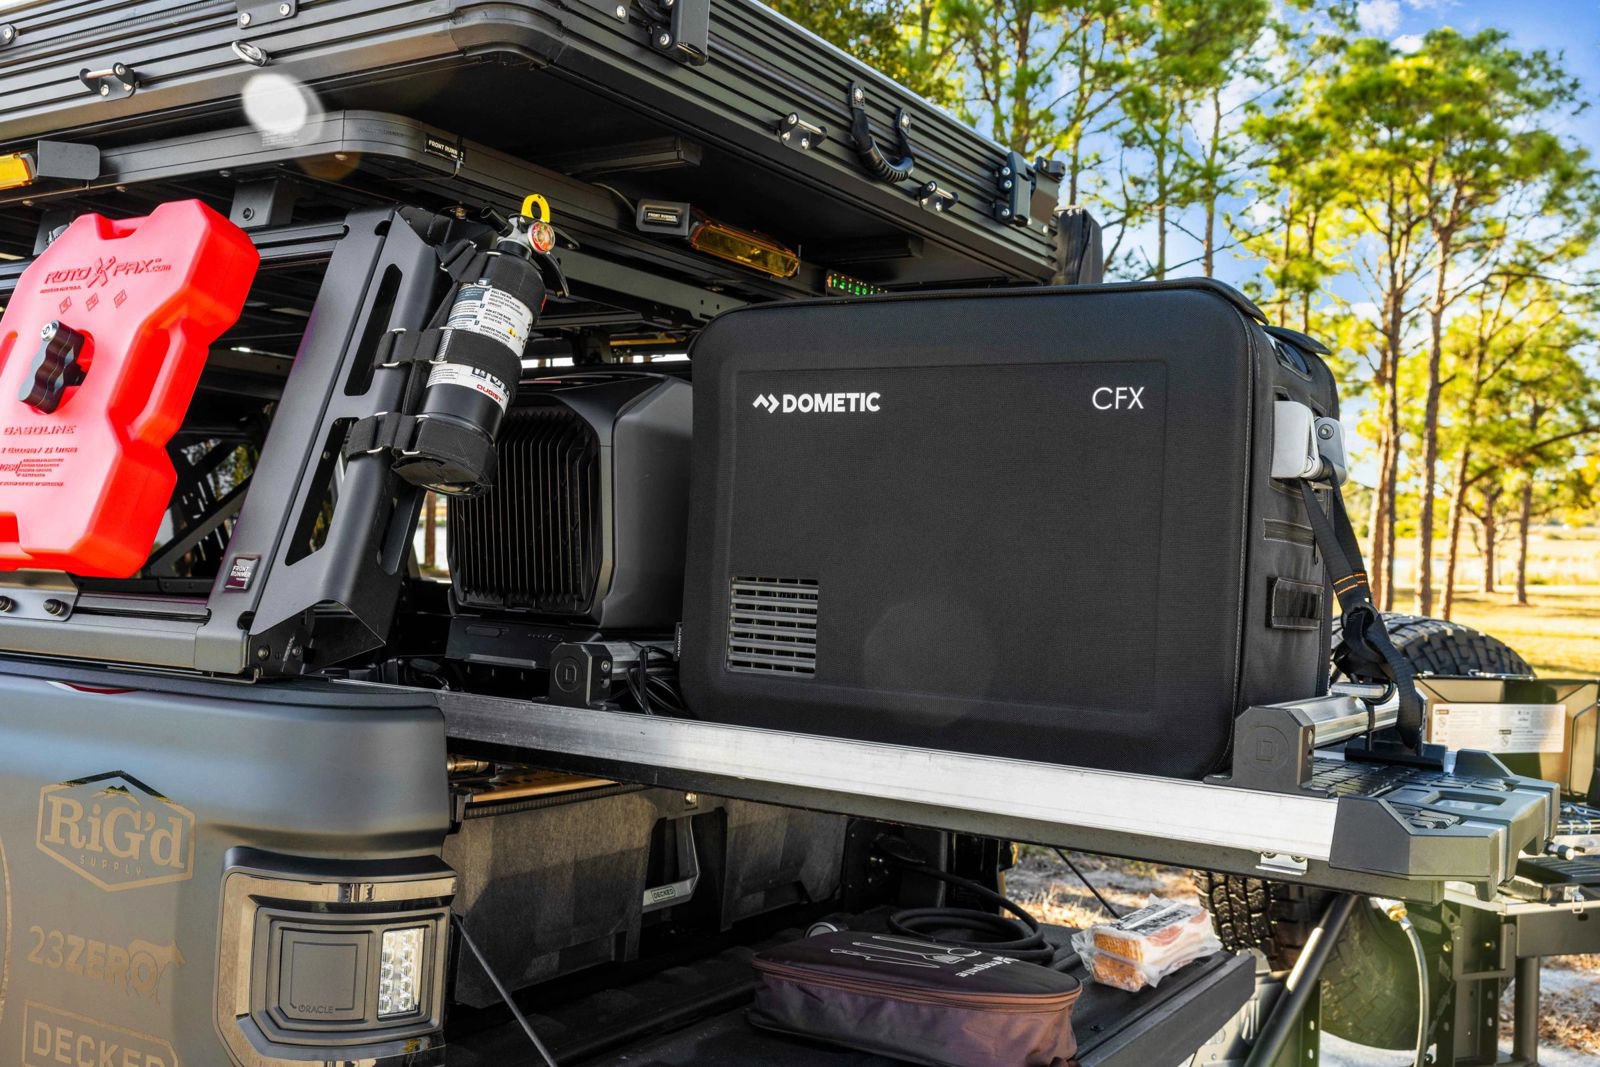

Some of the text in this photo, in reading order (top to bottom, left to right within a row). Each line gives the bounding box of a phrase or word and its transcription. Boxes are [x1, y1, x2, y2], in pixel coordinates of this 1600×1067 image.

[429, 140, 445, 150] FRONT
[445, 146, 464, 158] RUNNR
[782, 391, 881, 413] DOMETIC
[1092, 386, 1145, 410] CFX
[44, 794, 186, 869] RiG'd
[79, 854, 144, 876] SUPPLY
[27, 925, 159, 994] 23ZERO
[299, 1004, 334, 1014] ORACLE
